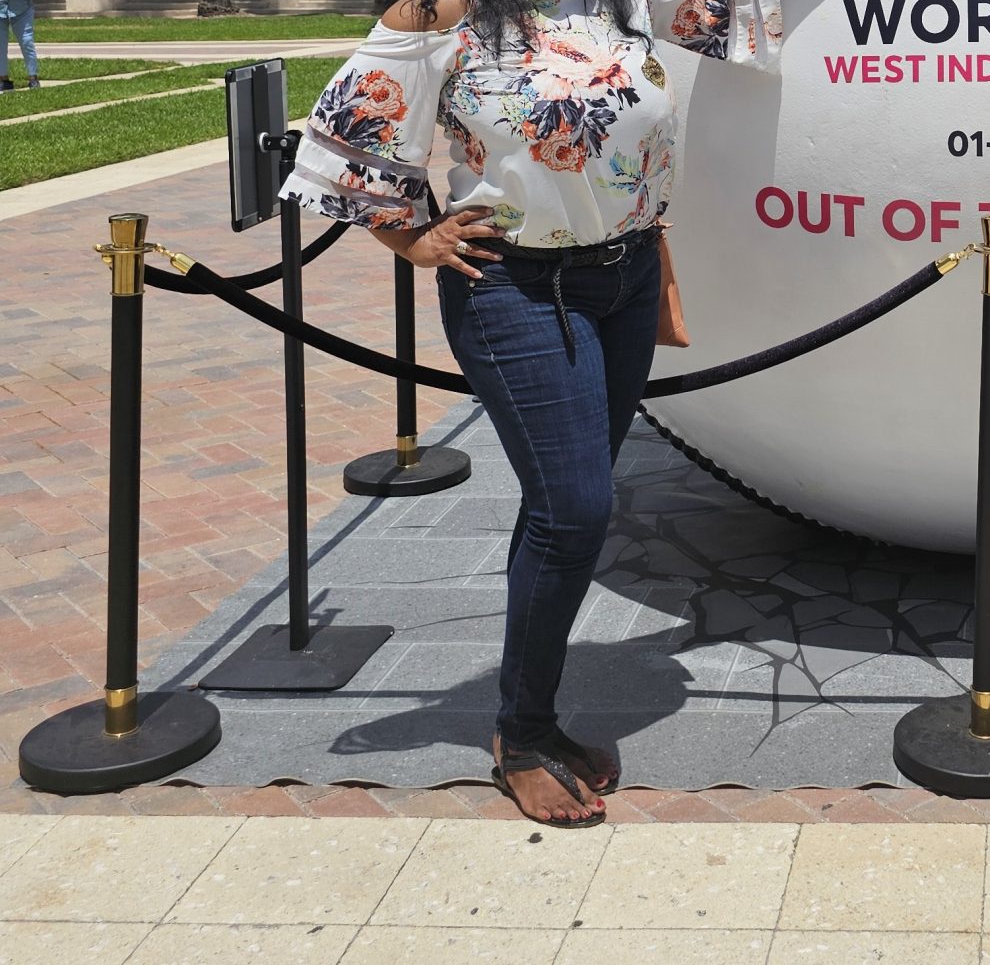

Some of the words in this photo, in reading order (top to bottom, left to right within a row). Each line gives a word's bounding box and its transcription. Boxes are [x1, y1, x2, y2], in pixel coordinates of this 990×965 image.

[824, 55, 926, 83] WEST
[755, 185, 865, 238] OUT
[882, 199, 961, 243] OF
